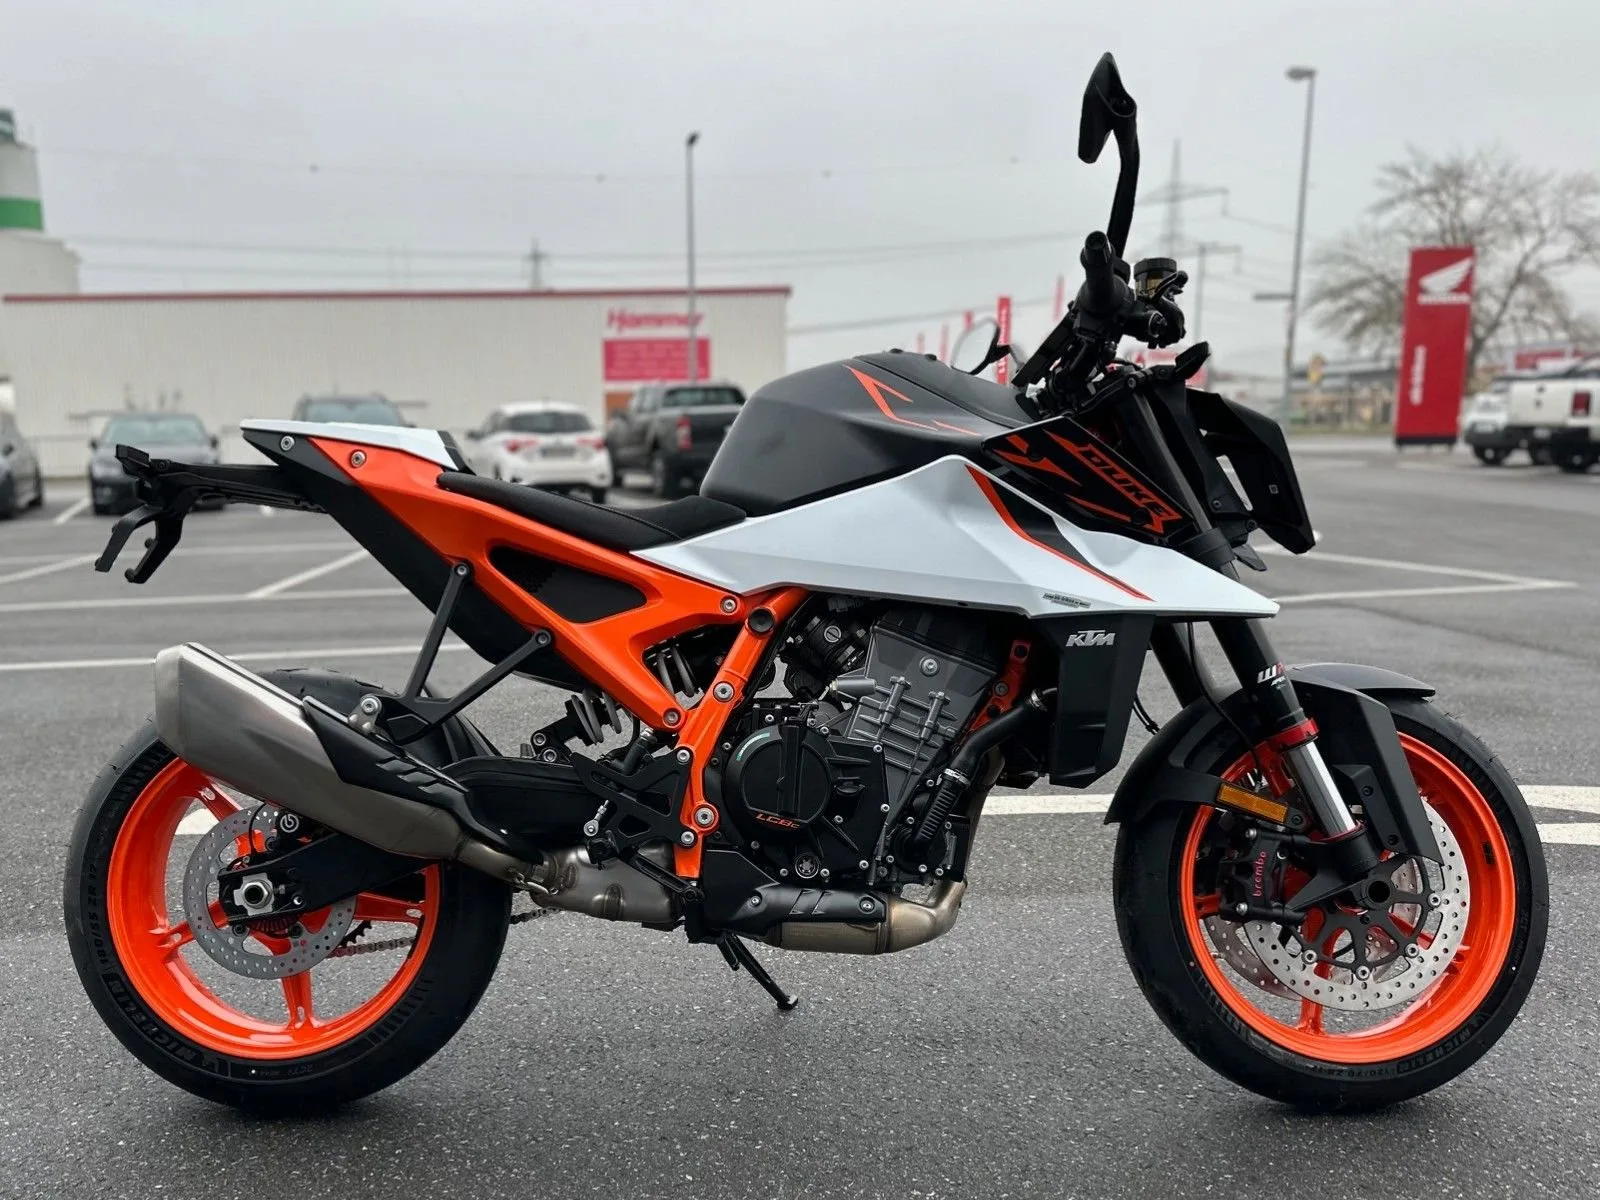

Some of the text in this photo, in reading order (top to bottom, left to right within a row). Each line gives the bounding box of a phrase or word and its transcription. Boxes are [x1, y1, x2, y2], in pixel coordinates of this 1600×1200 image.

[1068, 443, 1183, 533] DUKE
[1065, 629, 1116, 647] KTM
[1252, 851, 1267, 897] brembo
[108, 977, 197, 1062] MICHELIN
[1399, 1028, 1473, 1073] MICHELIN
